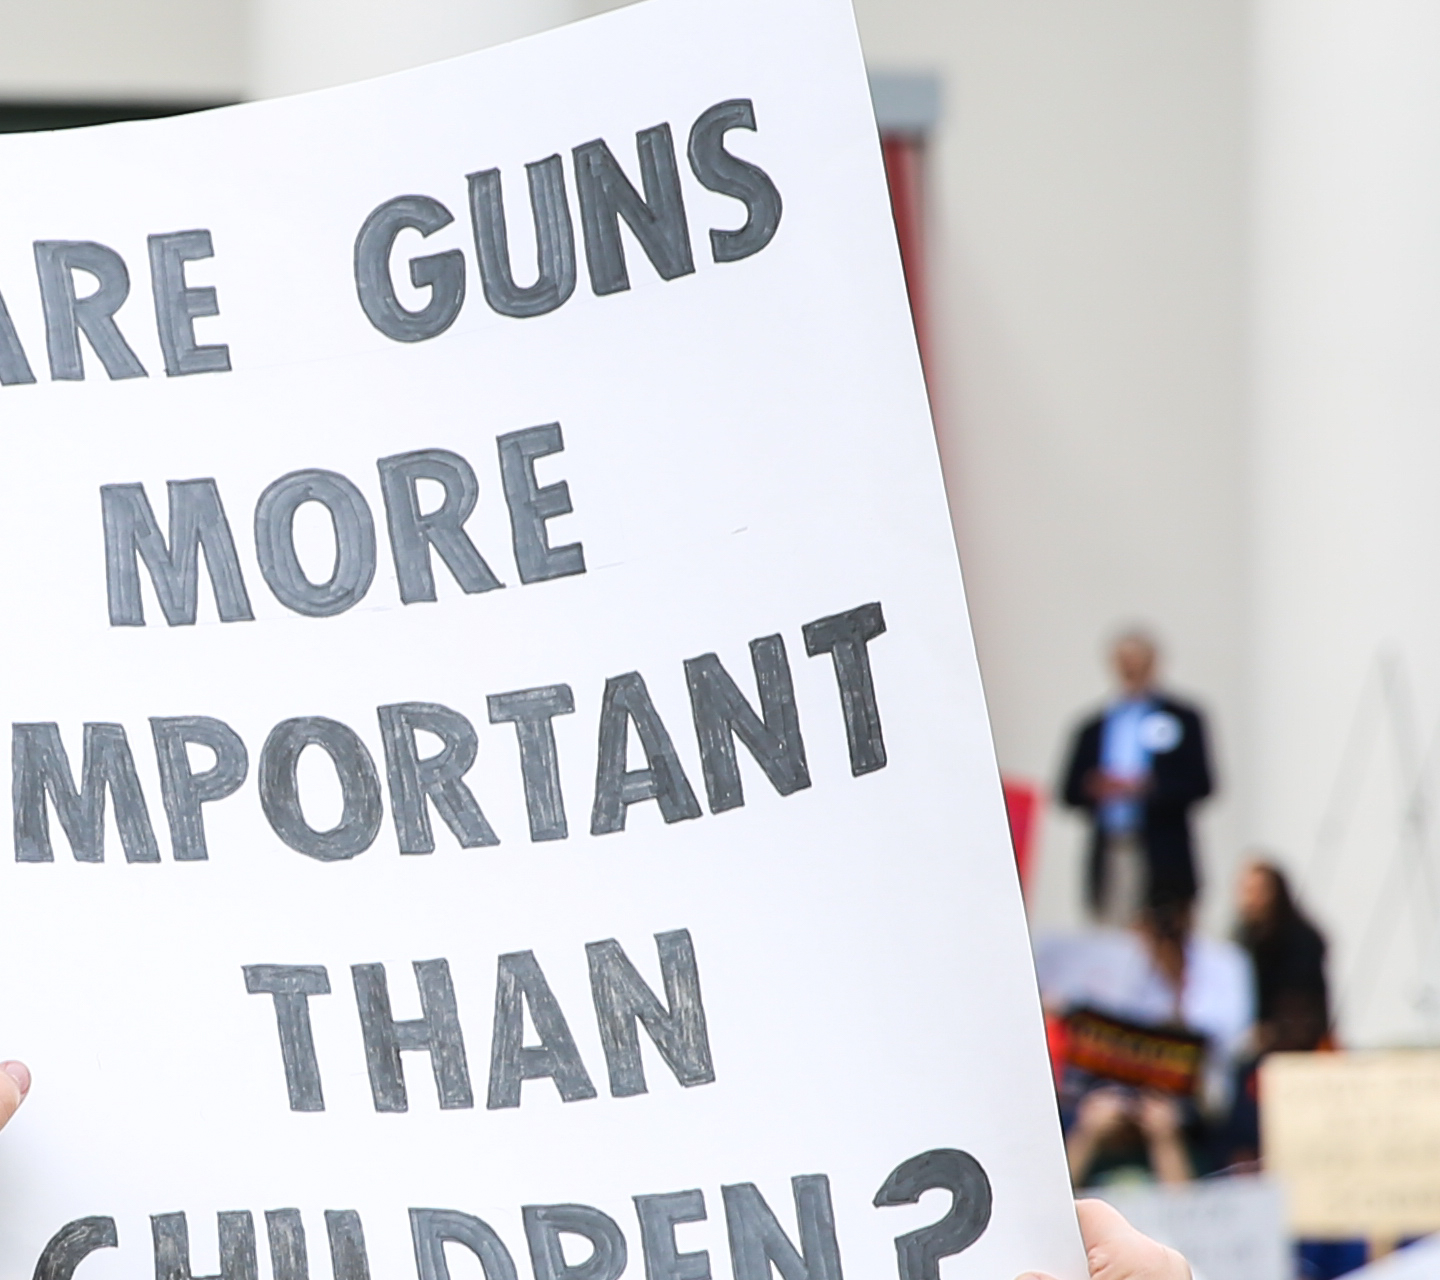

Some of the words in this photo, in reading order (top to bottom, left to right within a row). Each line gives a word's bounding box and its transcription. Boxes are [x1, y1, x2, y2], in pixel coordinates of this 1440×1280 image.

[352, 98, 783, 344] GUNS
[99, 421, 587, 628] MORE
[241, 928, 716, 1114] THAN
